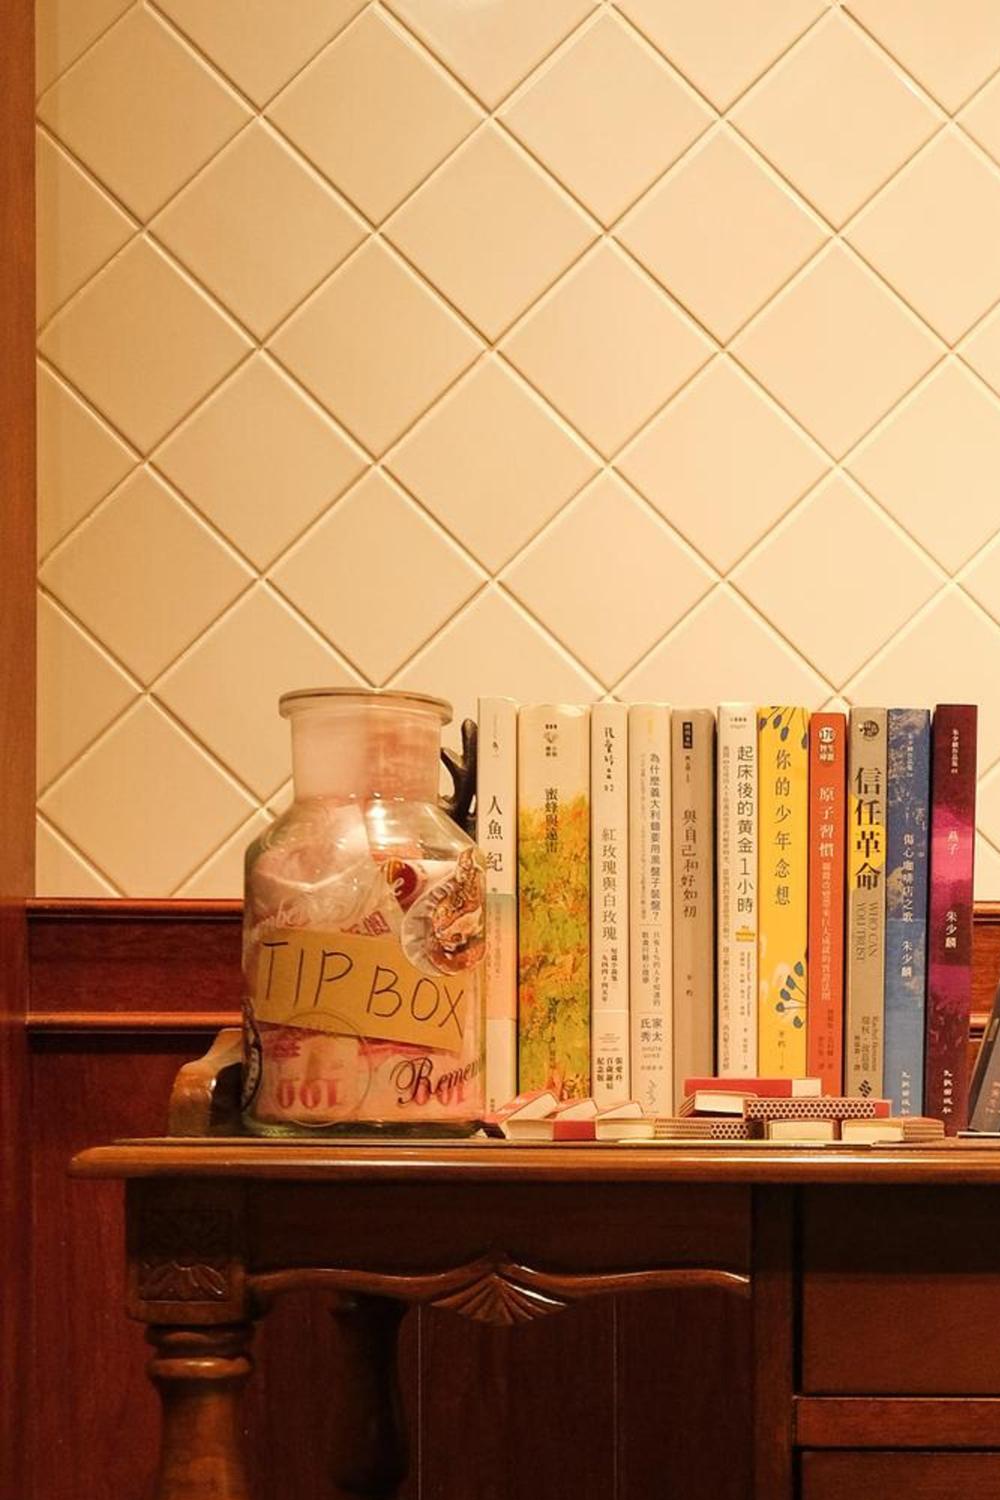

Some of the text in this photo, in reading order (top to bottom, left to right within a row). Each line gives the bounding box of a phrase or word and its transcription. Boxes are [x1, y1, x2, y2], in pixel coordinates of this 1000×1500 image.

[486, 795, 503, 872] 人魚紀
[681, 809, 698, 918] 與自己和好如初
[737, 746, 754, 914] 起床後的黃金1小時
[774, 749, 791, 906] 你的少年念想
[819, 787, 834, 857] 原子習慣
[855, 767, 882, 890] 信任革命
[601, 828, 618, 941] 紅玫瑰與白玫瑰
[262, 940, 353, 1008] TIP
[367, 965, 464, 1040] BOX
